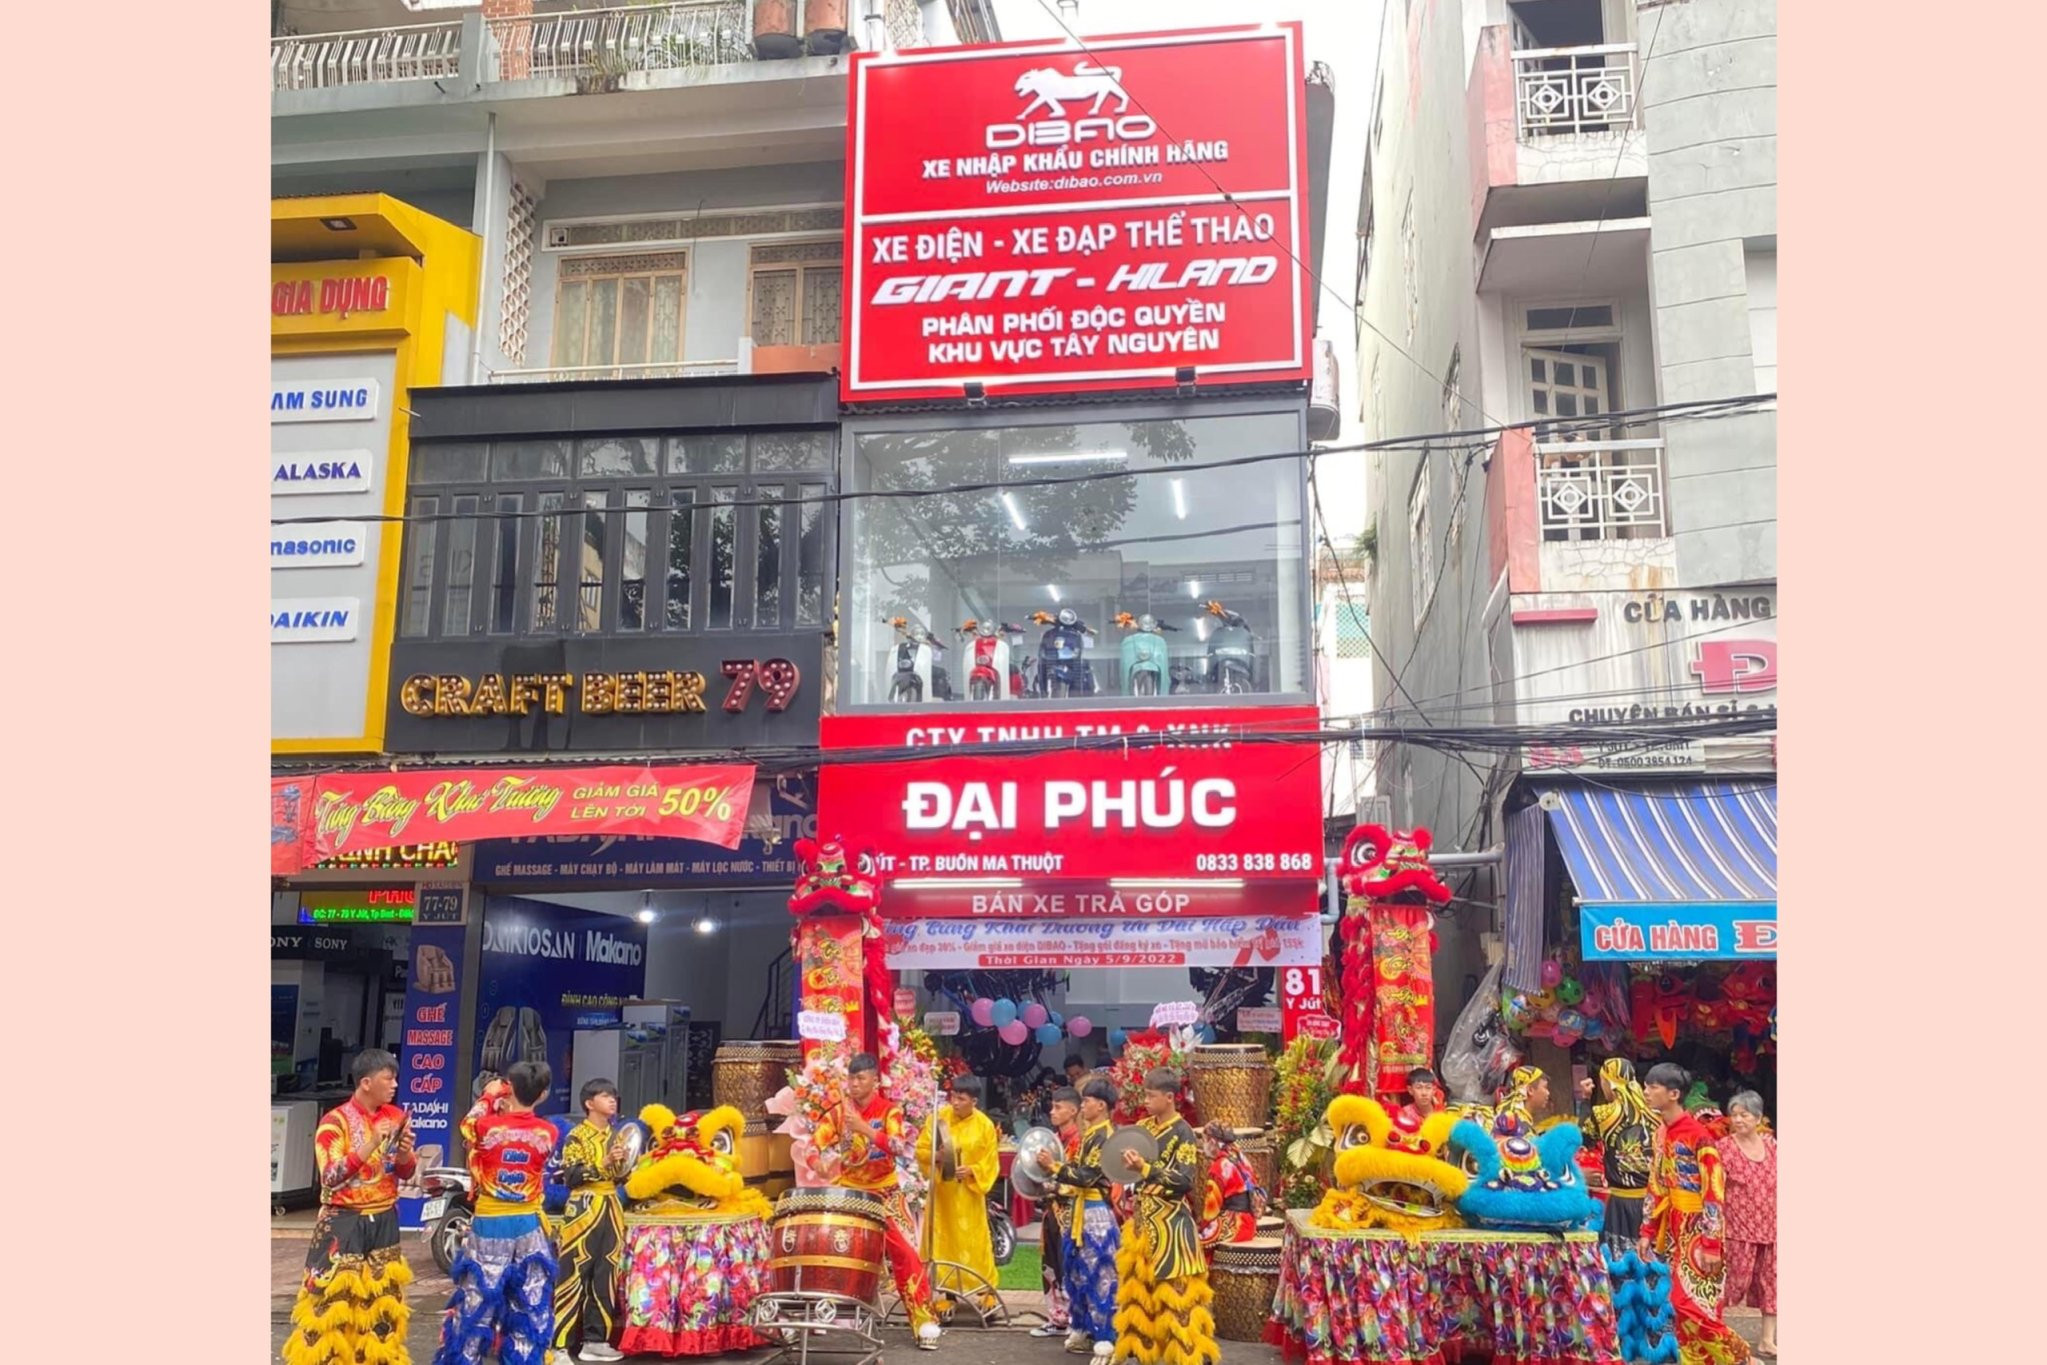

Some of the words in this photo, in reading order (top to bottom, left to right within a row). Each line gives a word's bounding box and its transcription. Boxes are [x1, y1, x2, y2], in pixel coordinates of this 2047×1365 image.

[985, 114, 1157, 149] DIBAO
[922, 158, 951, 180] XE
[955, 152, 1016, 181] NHẬP
[1022, 144, 1083, 174] KHẨU
[1089, 141, 1160, 169] CHÍNH
[1166, 140, 1229, 164] HÃNG
[871, 234, 909, 264] XE
[914, 225, 984, 264] ĐIỆN
[1011, 228, 1049, 256] XE
[1056, 223, 1117, 257] ĐẠP
[1125, 209, 1187, 248] THỂ
[1190, 212, 1276, 243] THAO
[870, 266, 1077, 305] GIANT
[1106, 255, 1279, 294] HILAND
[271, 279, 314, 316] GIA
[319, 276, 390, 319] DỤNG
[922, 308, 994, 338] PHÂN
[1002, 303, 1063, 333] PHỐI
[1070, 306, 1126, 335] ĐỘC
[1134, 297, 1227, 329] QUYỀN
[928, 341, 983, 364] KHU
[990, 335, 1043, 365] VỰC
[1051, 330, 1102, 358] TÂY
[1107, 325, 1220, 356] NGUYÊN
[311, 387, 367, 410] SUNG
[273, 460, 362, 482] ALASKA
[1623, 592, 1683, 624] CỬA
[1690, 596, 1772, 622] HÀNG
[271, 609, 349, 630] AIKIN
[400, 671, 573, 717] CRAFT
[581, 670, 706, 716] BEER
[719, 656, 800, 713] 79
[906, 726, 966, 748] CTY
[572, 782, 620, 800] GIẢM
[625, 780, 659, 799] GIÁ
[657, 786, 732, 822] 50%
[902, 780, 1018, 841] ĐẠI
[1043, 767, 1237, 829] PHÚC
[513, 864, 552, 876] MASSAGE
[560, 861, 578, 875] MÁY
[625, 861, 645, 875] MÁY
[691, 860, 712, 875] MÁY
[910, 855, 931, 871] TP.
[935, 852, 979, 871] BUÔN
[982, 855, 1008, 871] MA
[1011, 851, 1064, 873] THUỘT
[1196, 853, 1238, 871] 0833
[1243, 853, 1276, 871] 838
[1280, 852, 1312, 871] 868
[972, 890, 1024, 913] BÁN
[1033, 894, 1065, 913] XE
[1075, 890, 1126, 913] TRẢ
[1136, 889, 1190, 913] GÓP
[315, 937, 348, 951] SONY
[1595, 918, 1645, 952] CỬA
[1650, 920, 1720, 952] HÀNG
[585, 930, 642, 966] Makano
[1105, 953, 1177, 965] 5/9/2022
[1285, 968, 1321, 996] 81
[416, 1002, 447, 1023] GHẾ
[1286, 998, 1295, 1010] Y
[1299, 997, 1322, 1010] Jút
[407, 1029, 453, 1046] MASSAGE
[411, 1053, 445, 1070] CAO
[410, 1072, 443, 1094] CẤP
[402, 1098, 449, 1117] TADASHI
[409, 1116, 448, 1129] akano
